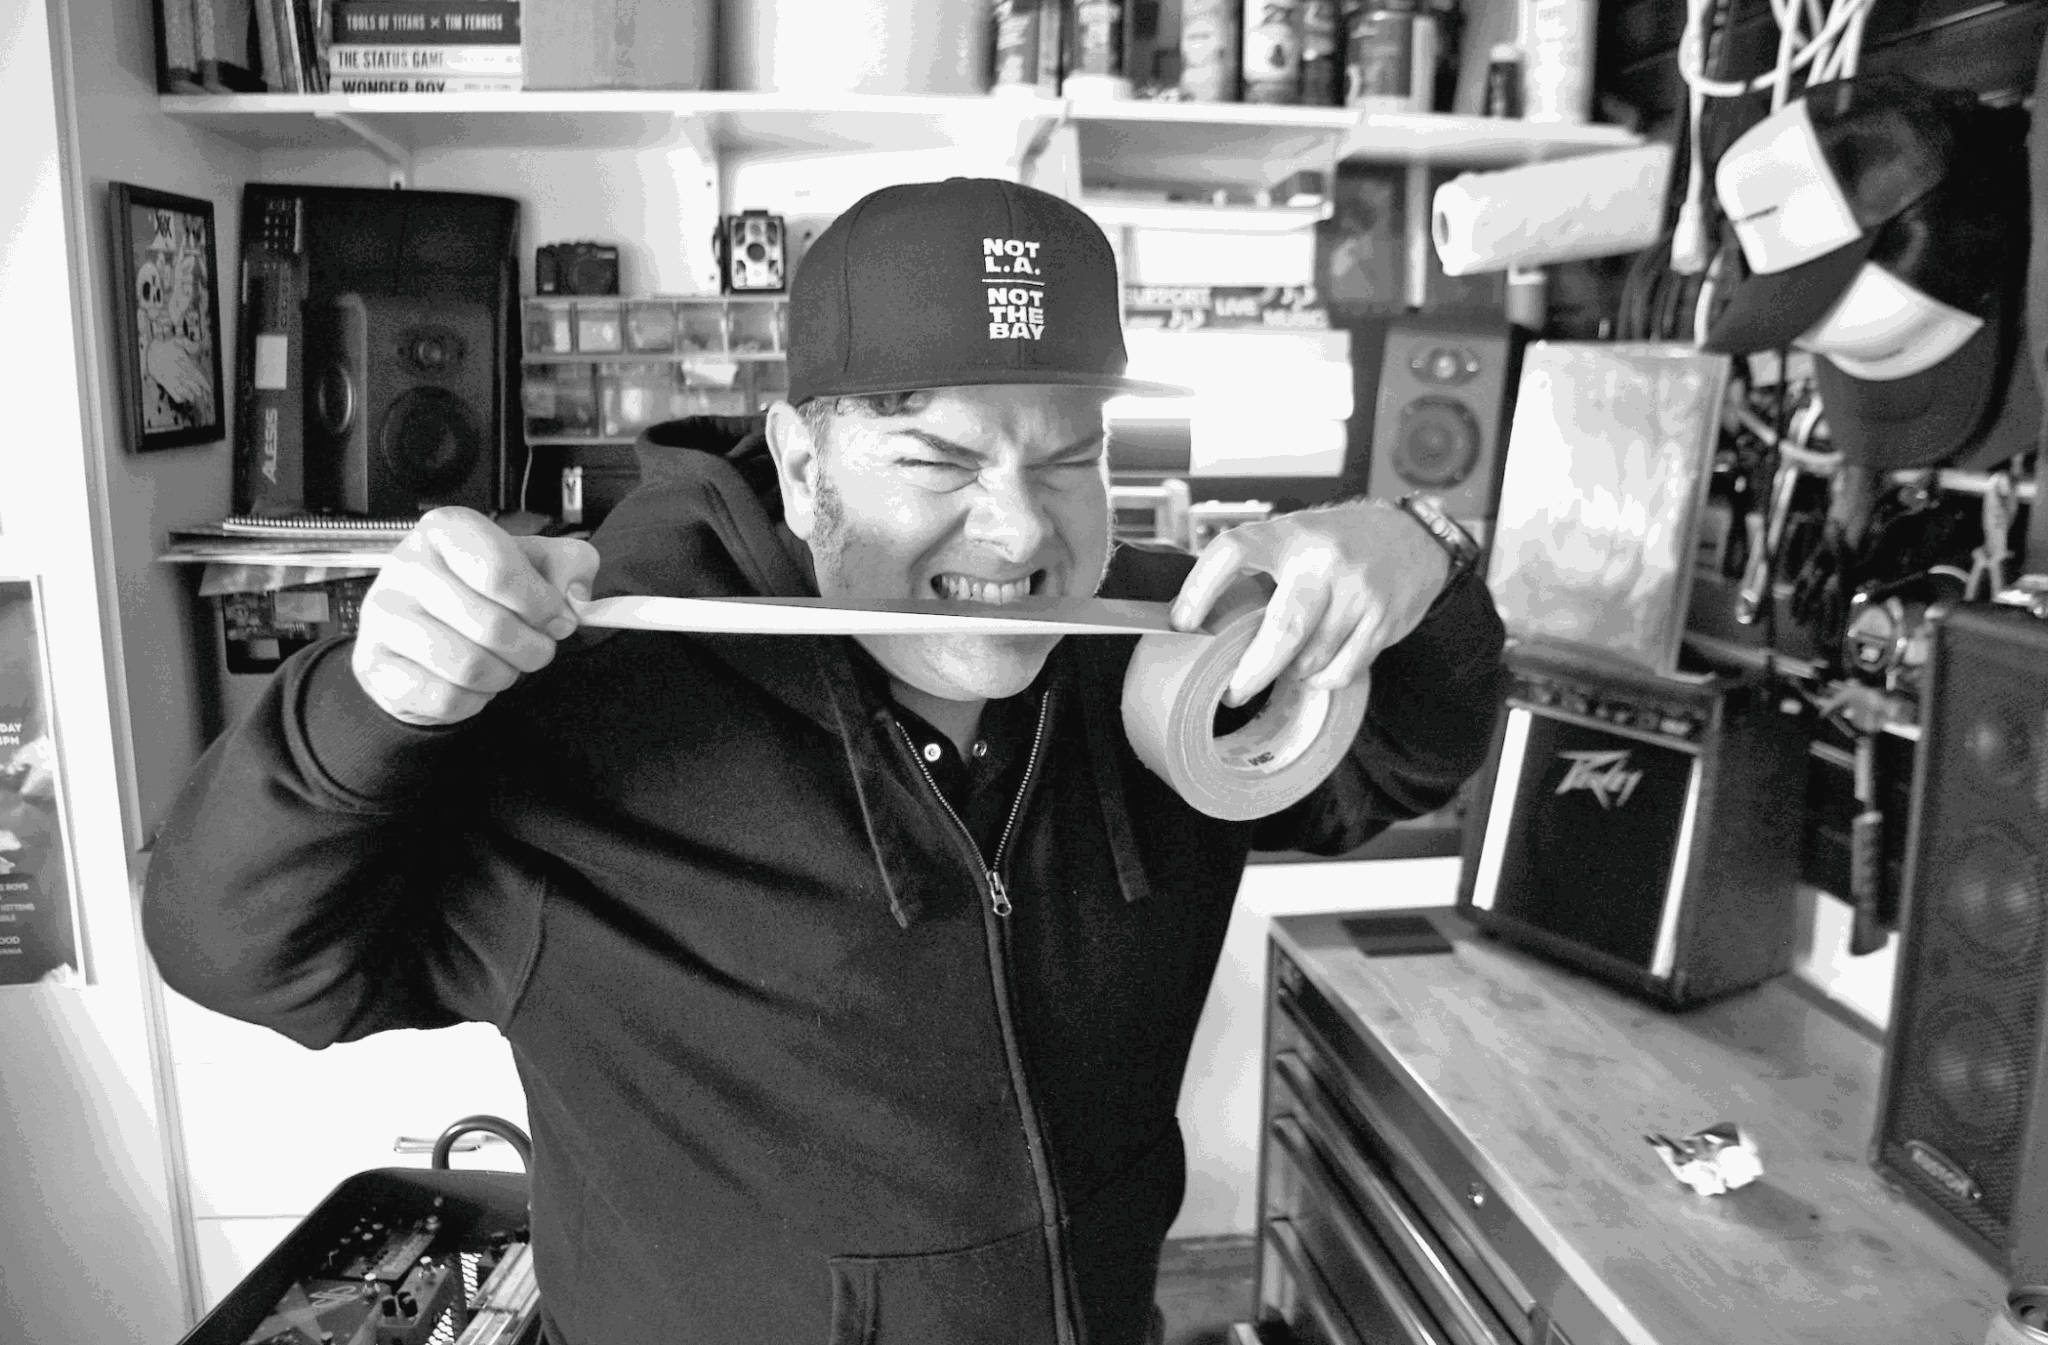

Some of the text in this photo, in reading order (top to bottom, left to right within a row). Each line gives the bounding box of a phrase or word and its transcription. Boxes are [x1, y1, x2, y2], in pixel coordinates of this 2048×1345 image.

[347, 13, 503, 31] TOOLS OF TITANS TIM FERRISS
[338, 51, 358, 68] THE
[363, 51, 408, 69] STATUS
[412, 51, 444, 68] GAME
[983, 238, 1040, 258] NOT
[984, 256, 1041, 275] L.A.
[987, 288, 1044, 307] NOT
[989, 305, 1044, 324] THE
[989, 322, 1045, 340] BAY
[262, 408, 278, 485] ALESIS
